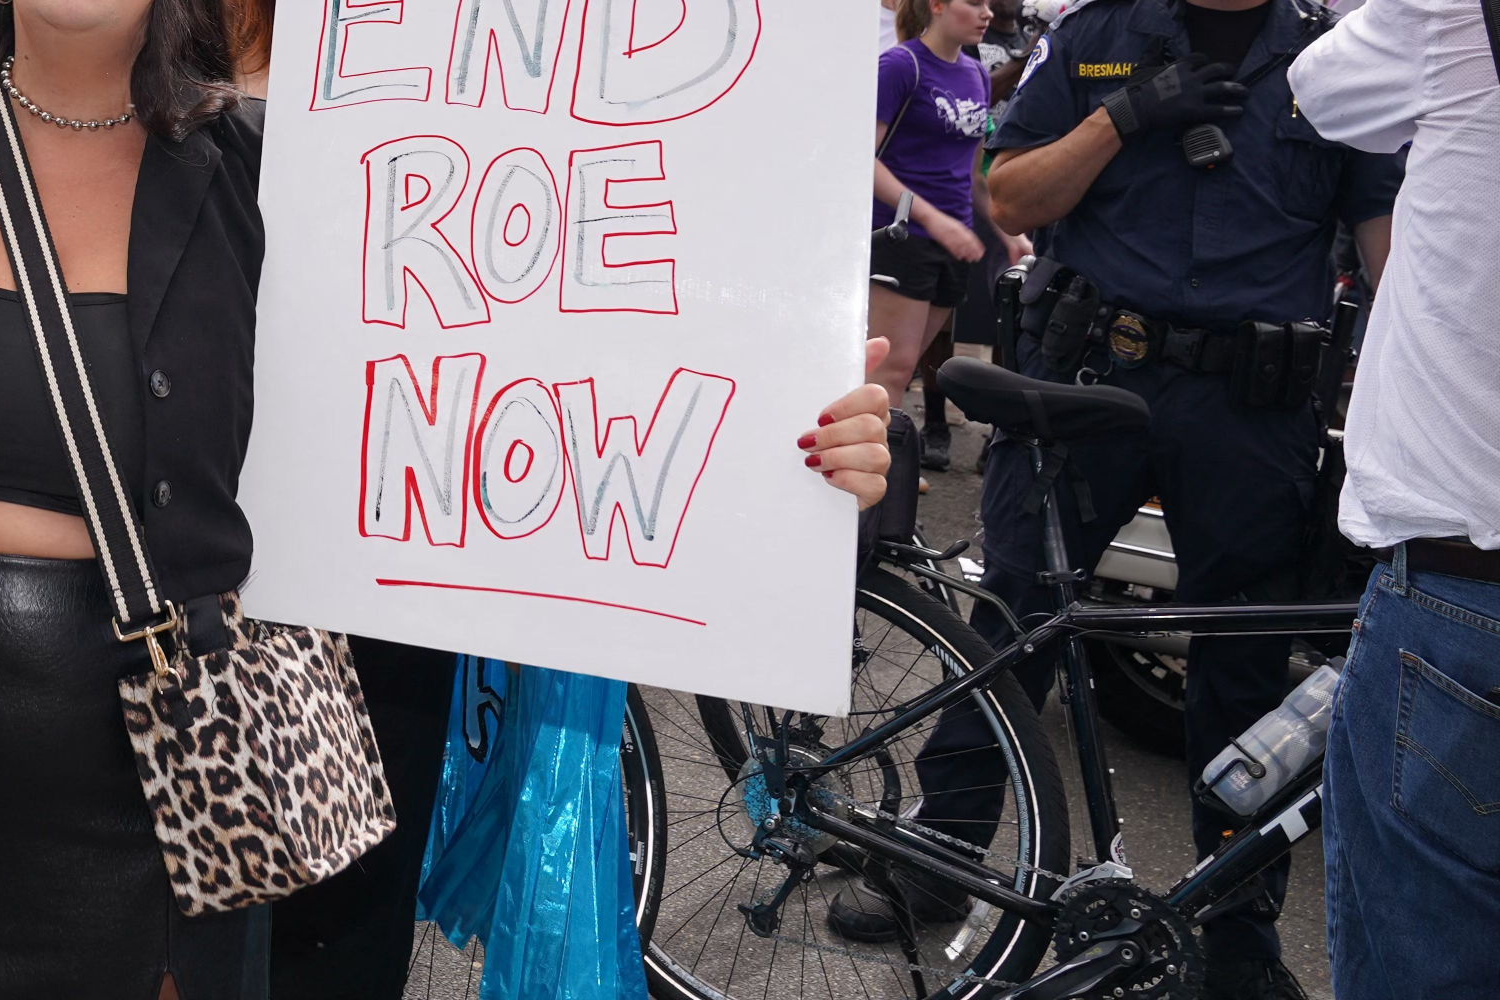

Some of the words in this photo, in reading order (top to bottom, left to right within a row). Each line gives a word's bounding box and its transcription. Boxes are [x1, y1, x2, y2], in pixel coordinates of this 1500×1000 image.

[1079, 63, 1137, 78] BRESNAH
[361, 134, 678, 329] ROE
[359, 354, 736, 569] NOW
